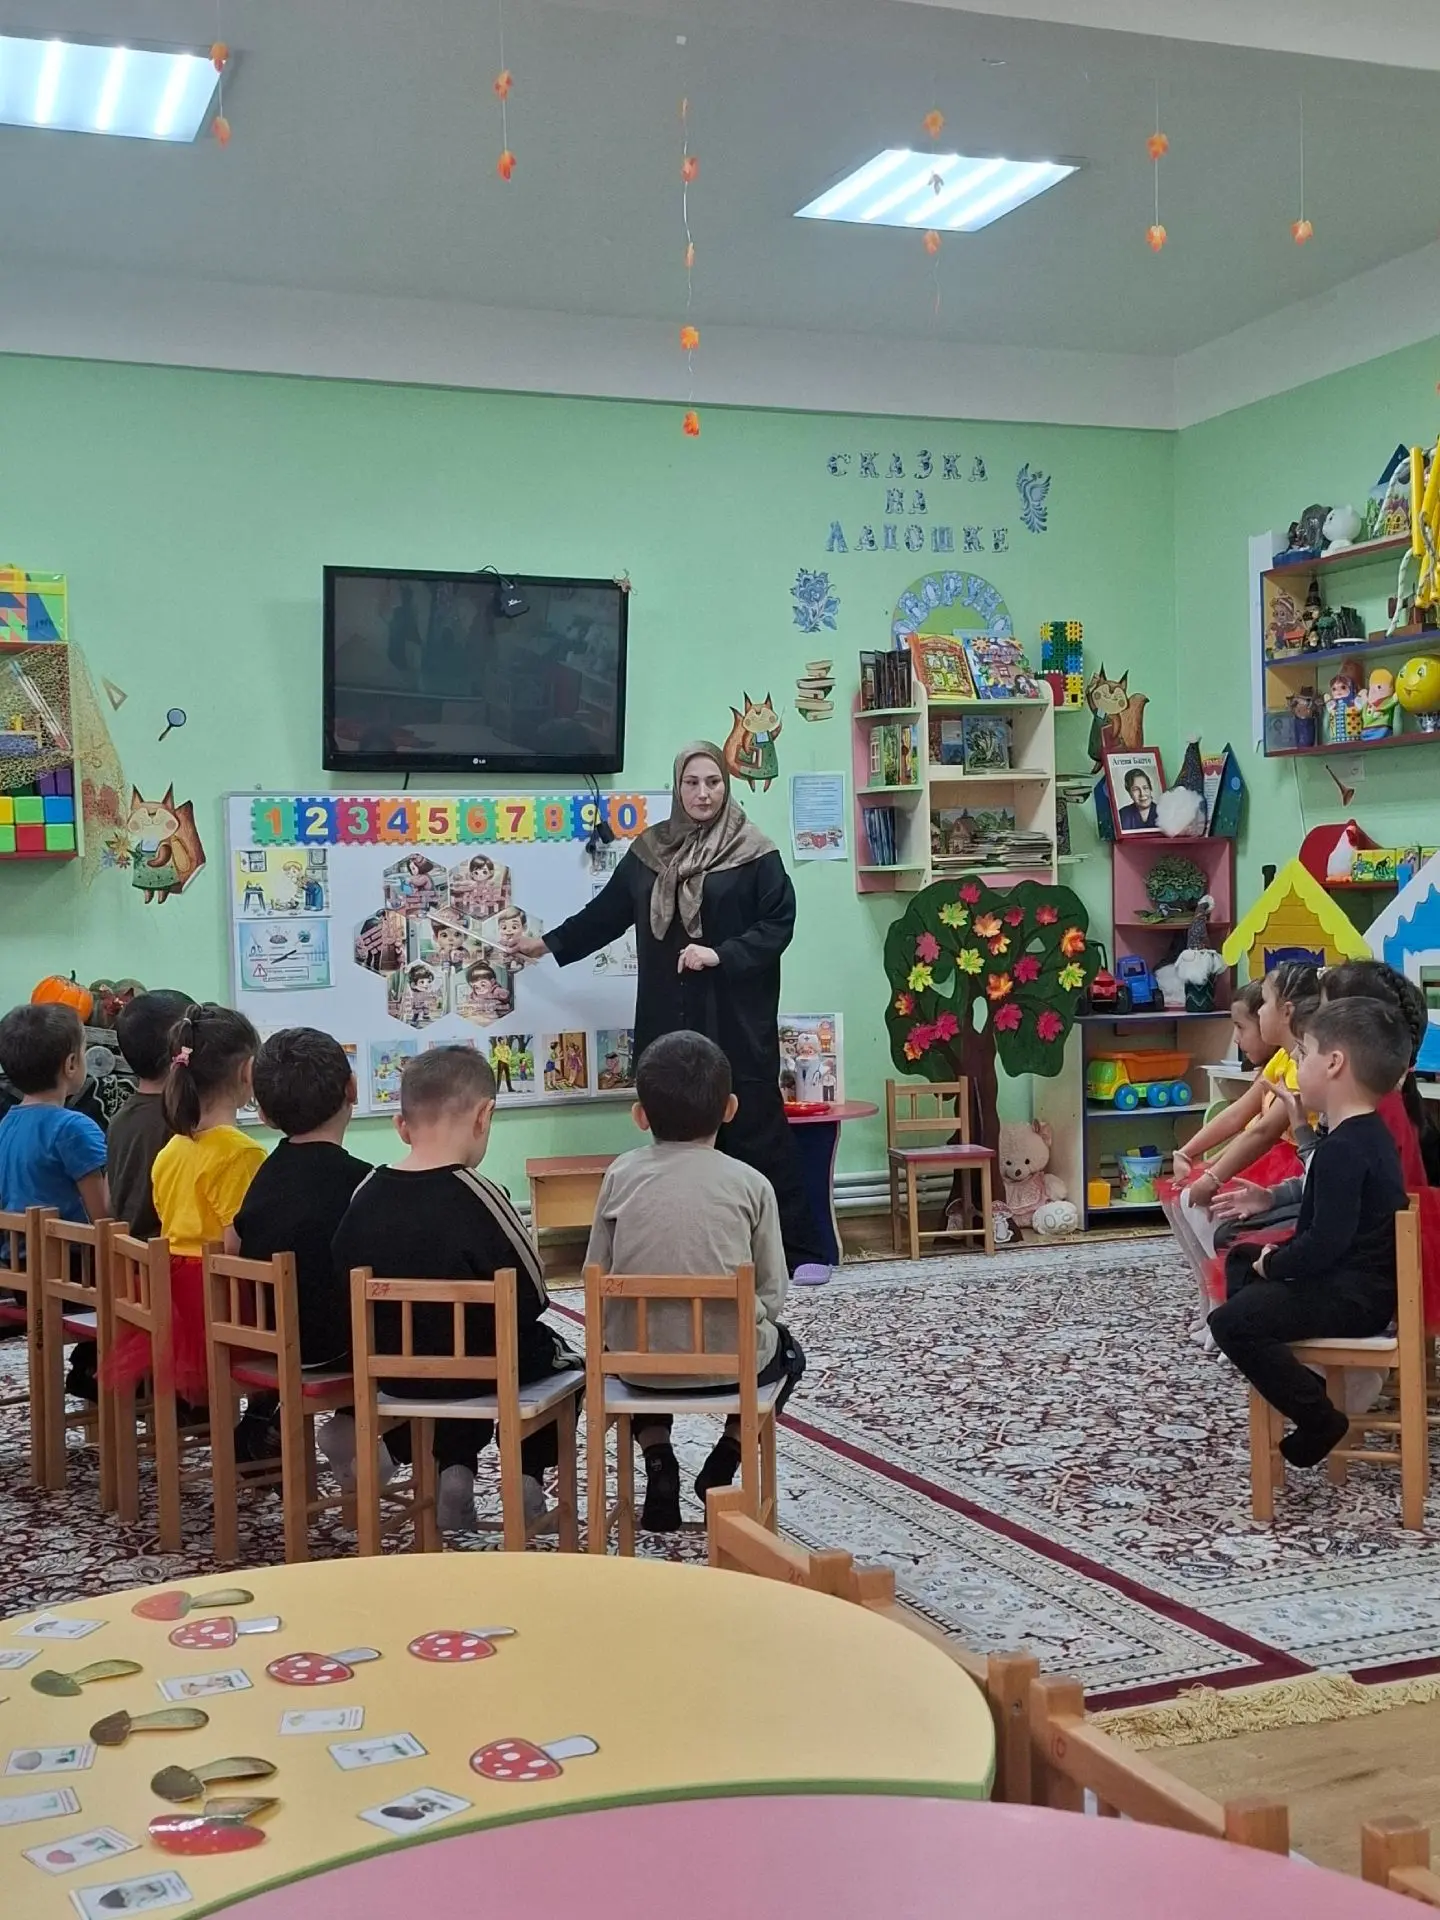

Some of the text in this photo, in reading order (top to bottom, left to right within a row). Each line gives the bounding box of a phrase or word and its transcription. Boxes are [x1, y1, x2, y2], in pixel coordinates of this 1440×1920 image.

[827, 450, 988, 483] СКАЗКА
[885, 487, 929, 514] НА
[264, 804, 637, 836] 1 2 3 4 5 6 7 8 9 0
